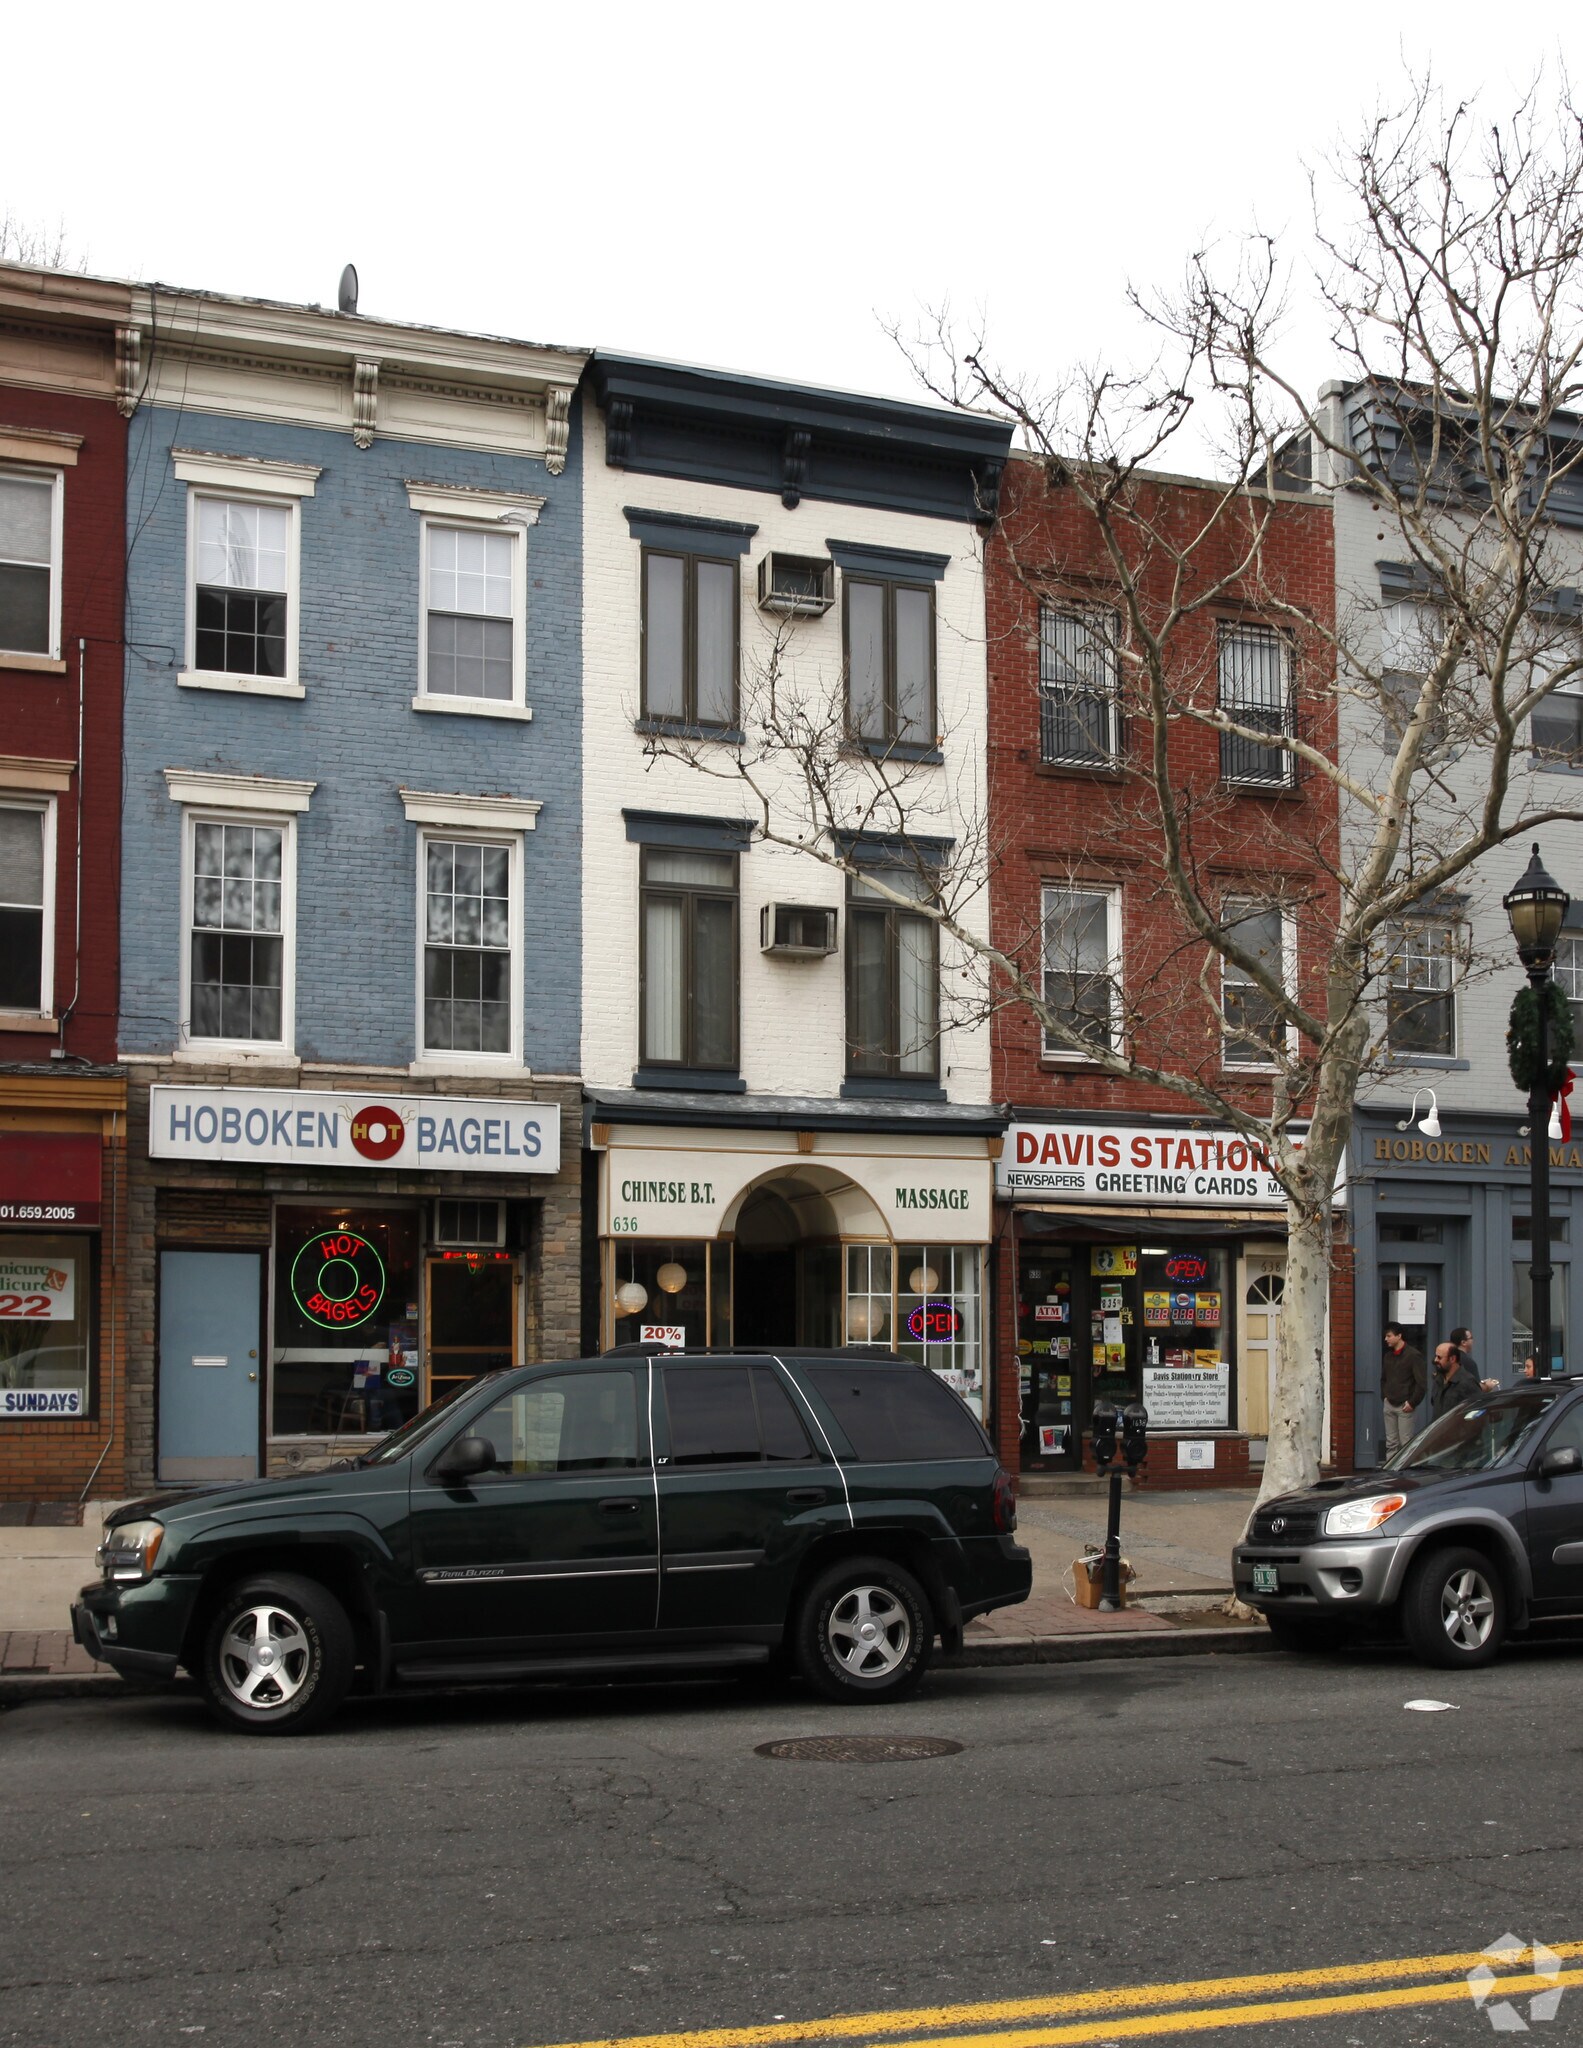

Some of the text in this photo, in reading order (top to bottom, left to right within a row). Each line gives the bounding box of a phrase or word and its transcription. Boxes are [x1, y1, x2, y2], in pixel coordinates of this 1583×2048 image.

[169, 1104, 542, 1158] HOBOKEN HOT BAGELS
[1016, 1131, 1304, 1173] DAVIS STATION
[1373, 1137, 1583, 1168] HOBOKEN ANMA
[1007, 1174, 1085, 1188] NEWSPAPERS
[1095, 1172, 1258, 1196] GREETING CARDS
[1267, 1182, 1287, 1194] MA
[621, 1180, 716, 1204] CHINESE B.T.
[895, 1187, 970, 1210] MASSAGE
[0, 1205, 76, 1220] 01.659.2005
[613, 1216, 639, 1232] 636
[320, 1235, 366, 1259] HOT
[1165, 1260, 1208, 1277] OPEN
[1261, 1261, 1281, 1273] 638
[306, 1283, 378, 1321] BAGELS
[1037, 1307, 1060, 1316] ATM
[910, 1313, 959, 1332] OPEN
[644, 1326, 682, 1341] 20%
[942, 1374, 978, 1390] SSAGE
[1153, 1372, 1170, 1381] Davis
[1203, 1372, 1219, 1381] Store
[5, 1392, 78, 1412] SUNDAYS
